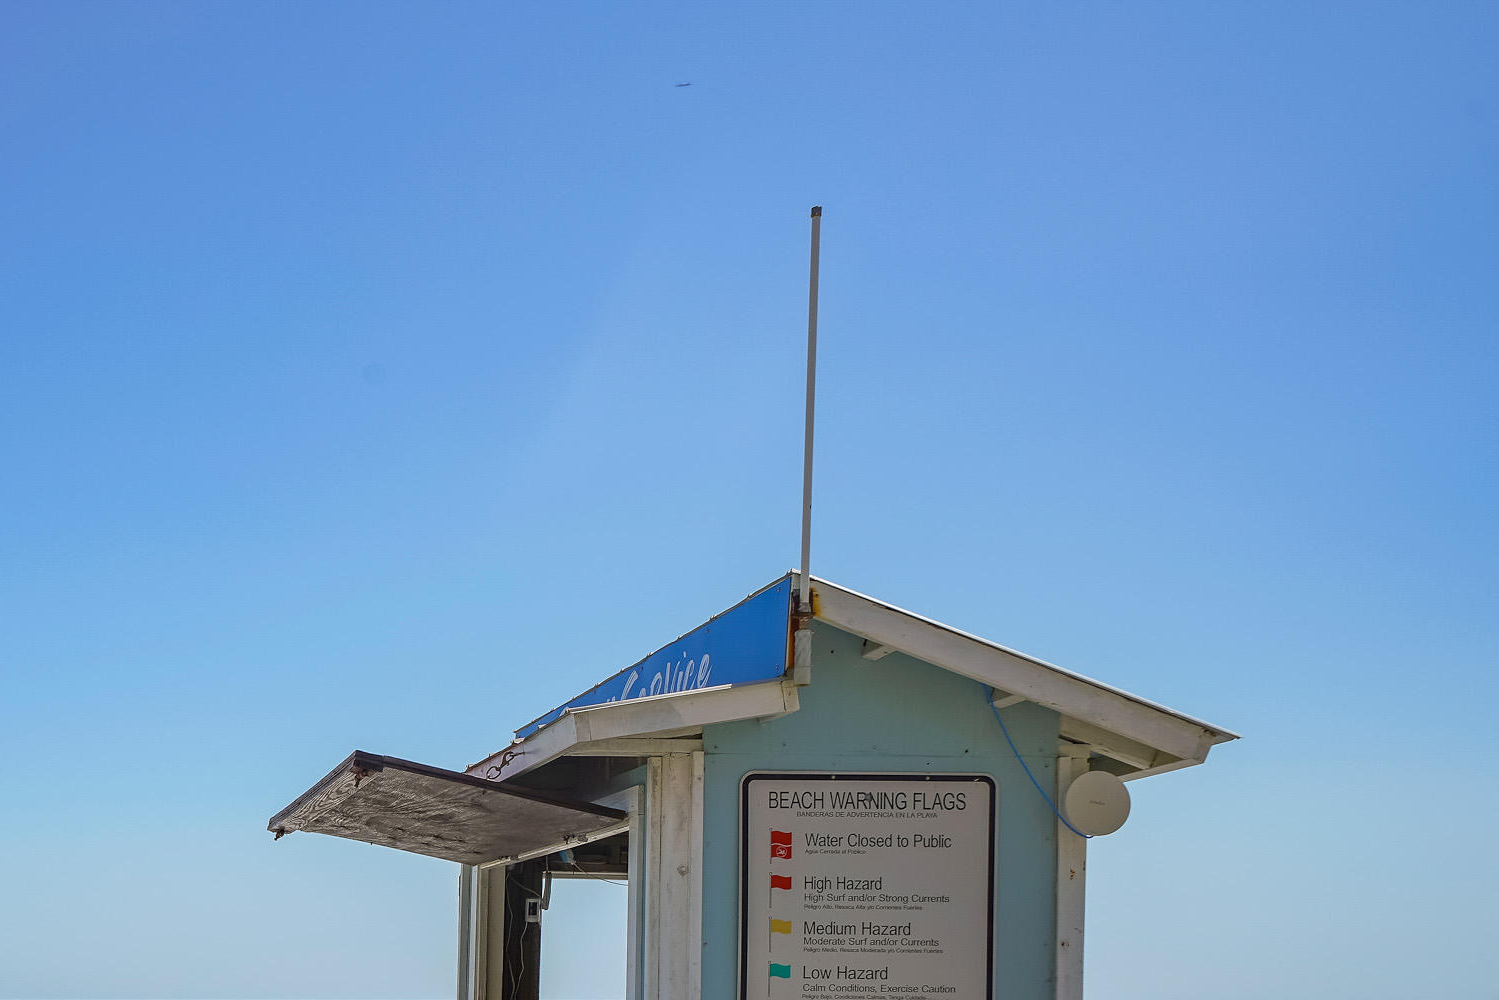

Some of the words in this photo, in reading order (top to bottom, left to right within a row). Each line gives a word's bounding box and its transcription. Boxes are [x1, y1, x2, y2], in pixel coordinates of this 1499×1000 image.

[768, 792, 824, 809] BEACH
[830, 792, 907, 810] WARNING
[913, 793, 966, 810] FLAGS
[805, 833, 843, 847] Water
[848, 834, 892, 848] Closed
[897, 835, 909, 848] to
[914, 834, 952, 848] Public
[804, 876, 831, 893] High
[837, 877, 882, 890] Hazard
[804, 893, 824, 903] High
[826, 894, 845, 902] Surf
[848, 894, 876, 902] and/or
[879, 894, 908, 904] Strong
[911, 895, 949, 903] Currents
[804, 921, 856, 935] Medium
[861, 922, 911, 936] Hazard
[803, 937, 845, 946] Moderate
[849, 938, 867, 946] Surf
[870, 938, 898, 946] and/or
[901, 938, 939, 946] Currents
[802, 966, 831, 979] Low
[837, 966, 888, 980] Hazard
[802, 984, 825, 992] Calm
[828, 984, 877, 993] Conditions,
[881, 985, 918, 993] Exercise
[922, 985, 955, 993] Caution
